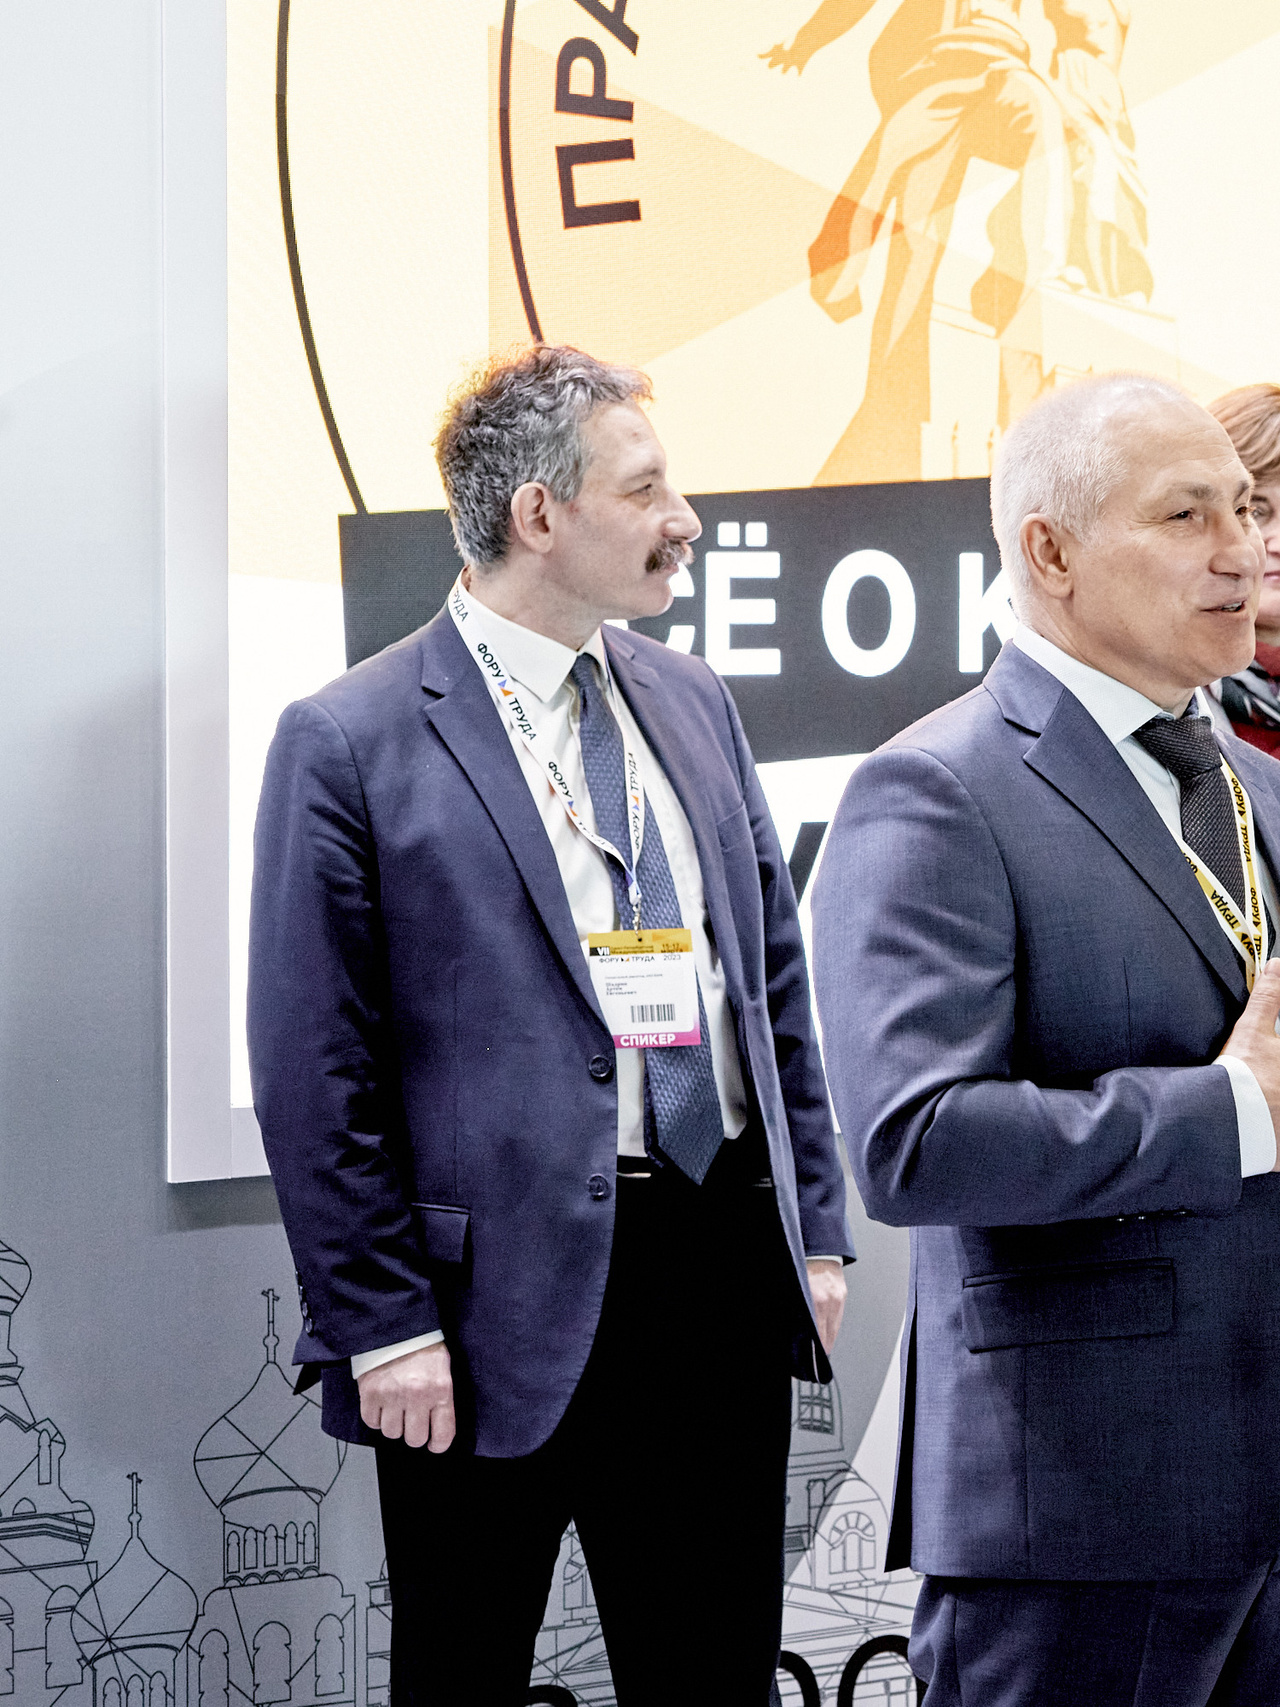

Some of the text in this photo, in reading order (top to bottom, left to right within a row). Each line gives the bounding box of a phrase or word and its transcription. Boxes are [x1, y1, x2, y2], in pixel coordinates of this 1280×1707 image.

[509, 697, 537, 741] ТРУДА
[1210, 889, 1240, 930] ТРУДА
[619, 1033, 677, 1047] СПИКЕР
